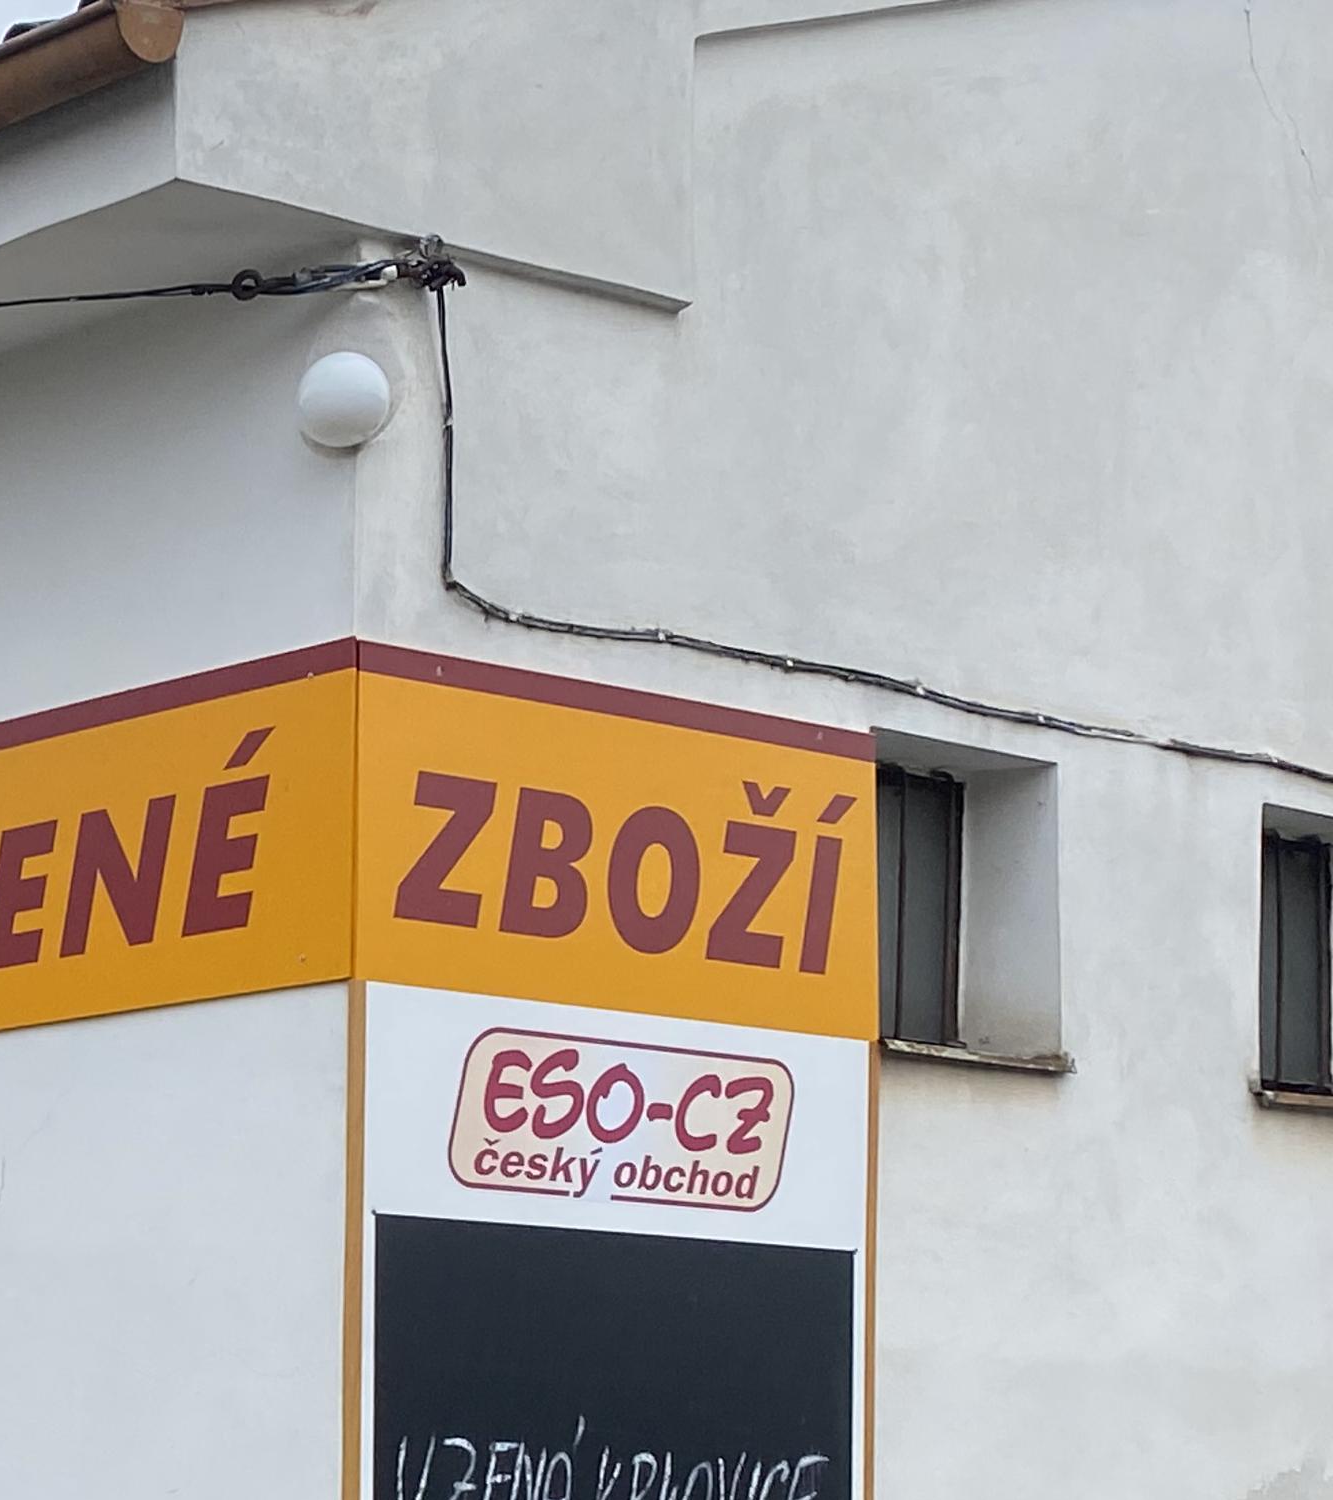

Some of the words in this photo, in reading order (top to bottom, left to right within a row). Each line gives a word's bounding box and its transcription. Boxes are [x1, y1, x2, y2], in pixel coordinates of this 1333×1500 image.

[394, 770, 859, 975] ZBOŽÍ
[483, 1048, 775, 1156] ESO-CZ
[473, 1138, 604, 1198] český
[612, 1155, 761, 1200] obchod
